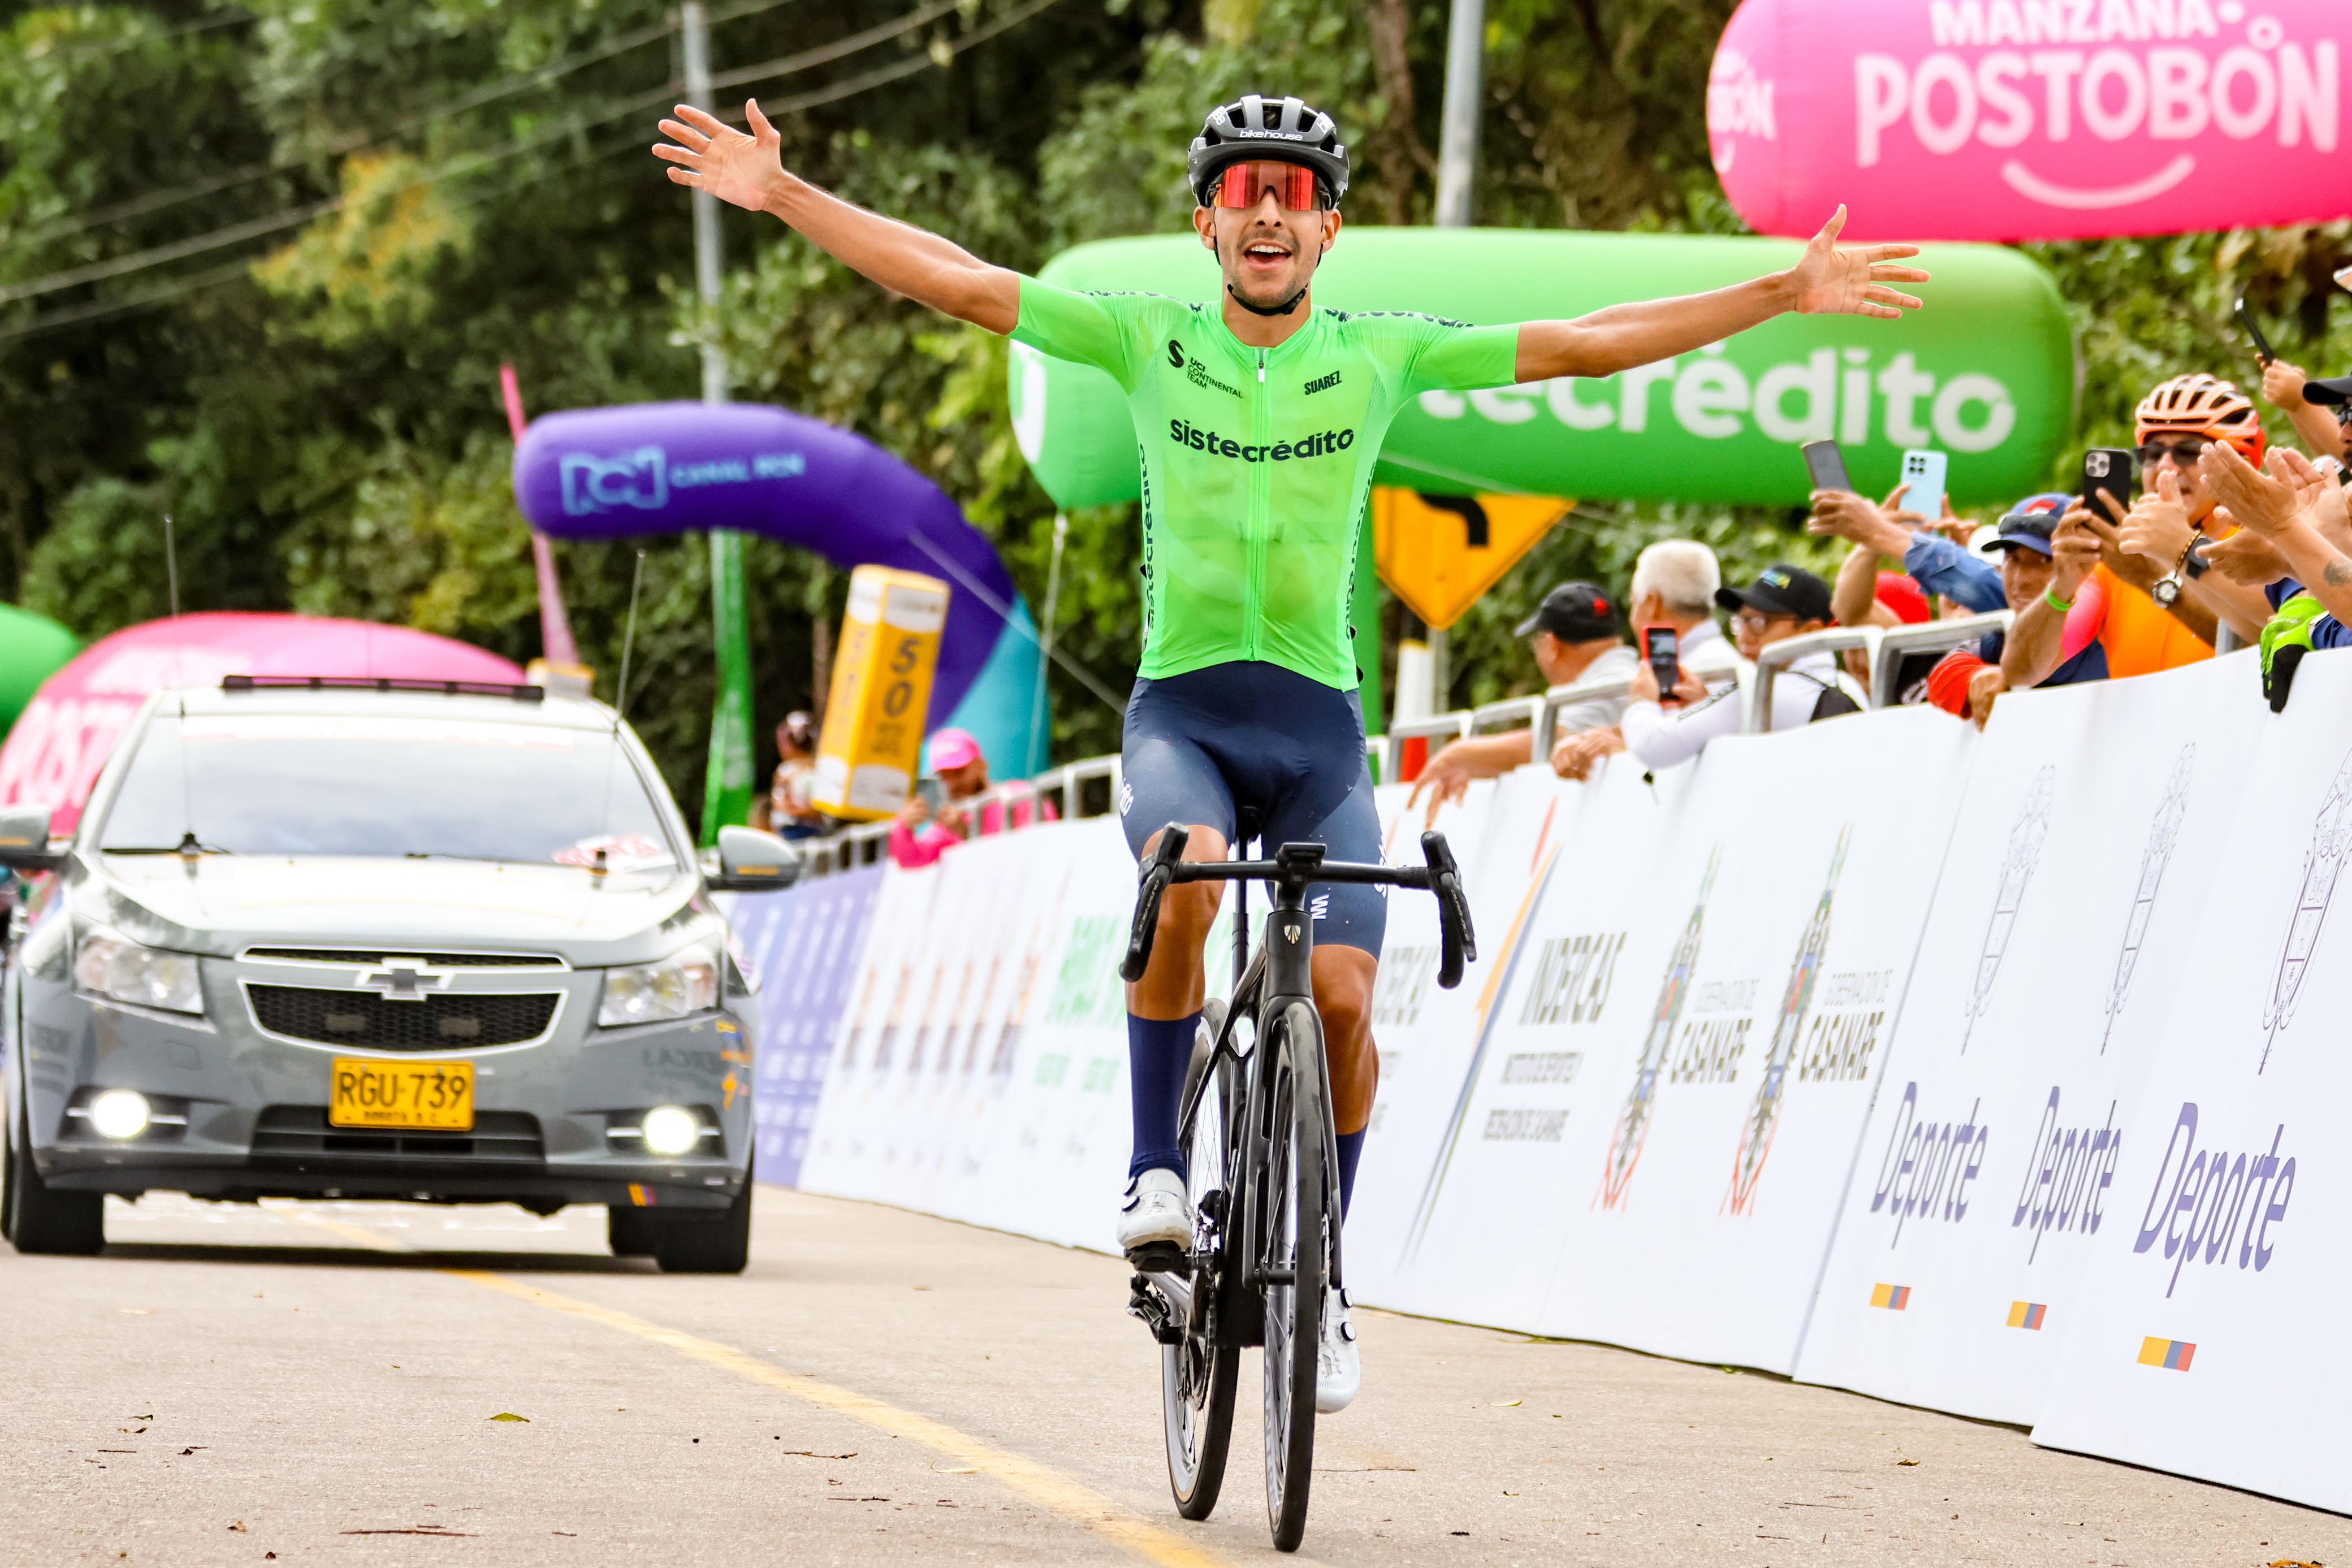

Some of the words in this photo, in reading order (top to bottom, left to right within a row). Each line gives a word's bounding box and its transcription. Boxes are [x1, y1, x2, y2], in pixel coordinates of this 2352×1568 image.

[1187, 371, 1207, 389] TEAM
[1188, 365, 1243, 399] CONTINENTAL
[1190, 352, 1205, 372] UCI
[1304, 371, 1342, 395] SUAREZ
[1170, 419, 1354, 462] sistecrédito
[1670, 1019, 1753, 1084] CASANARE
[1799, 1011, 1885, 1082] CASANARE
[1870, 1081, 1988, 1250] Deporte
[2012, 1086, 2121, 1266] Deporte
[2133, 1102, 2296, 1299] Deporte
